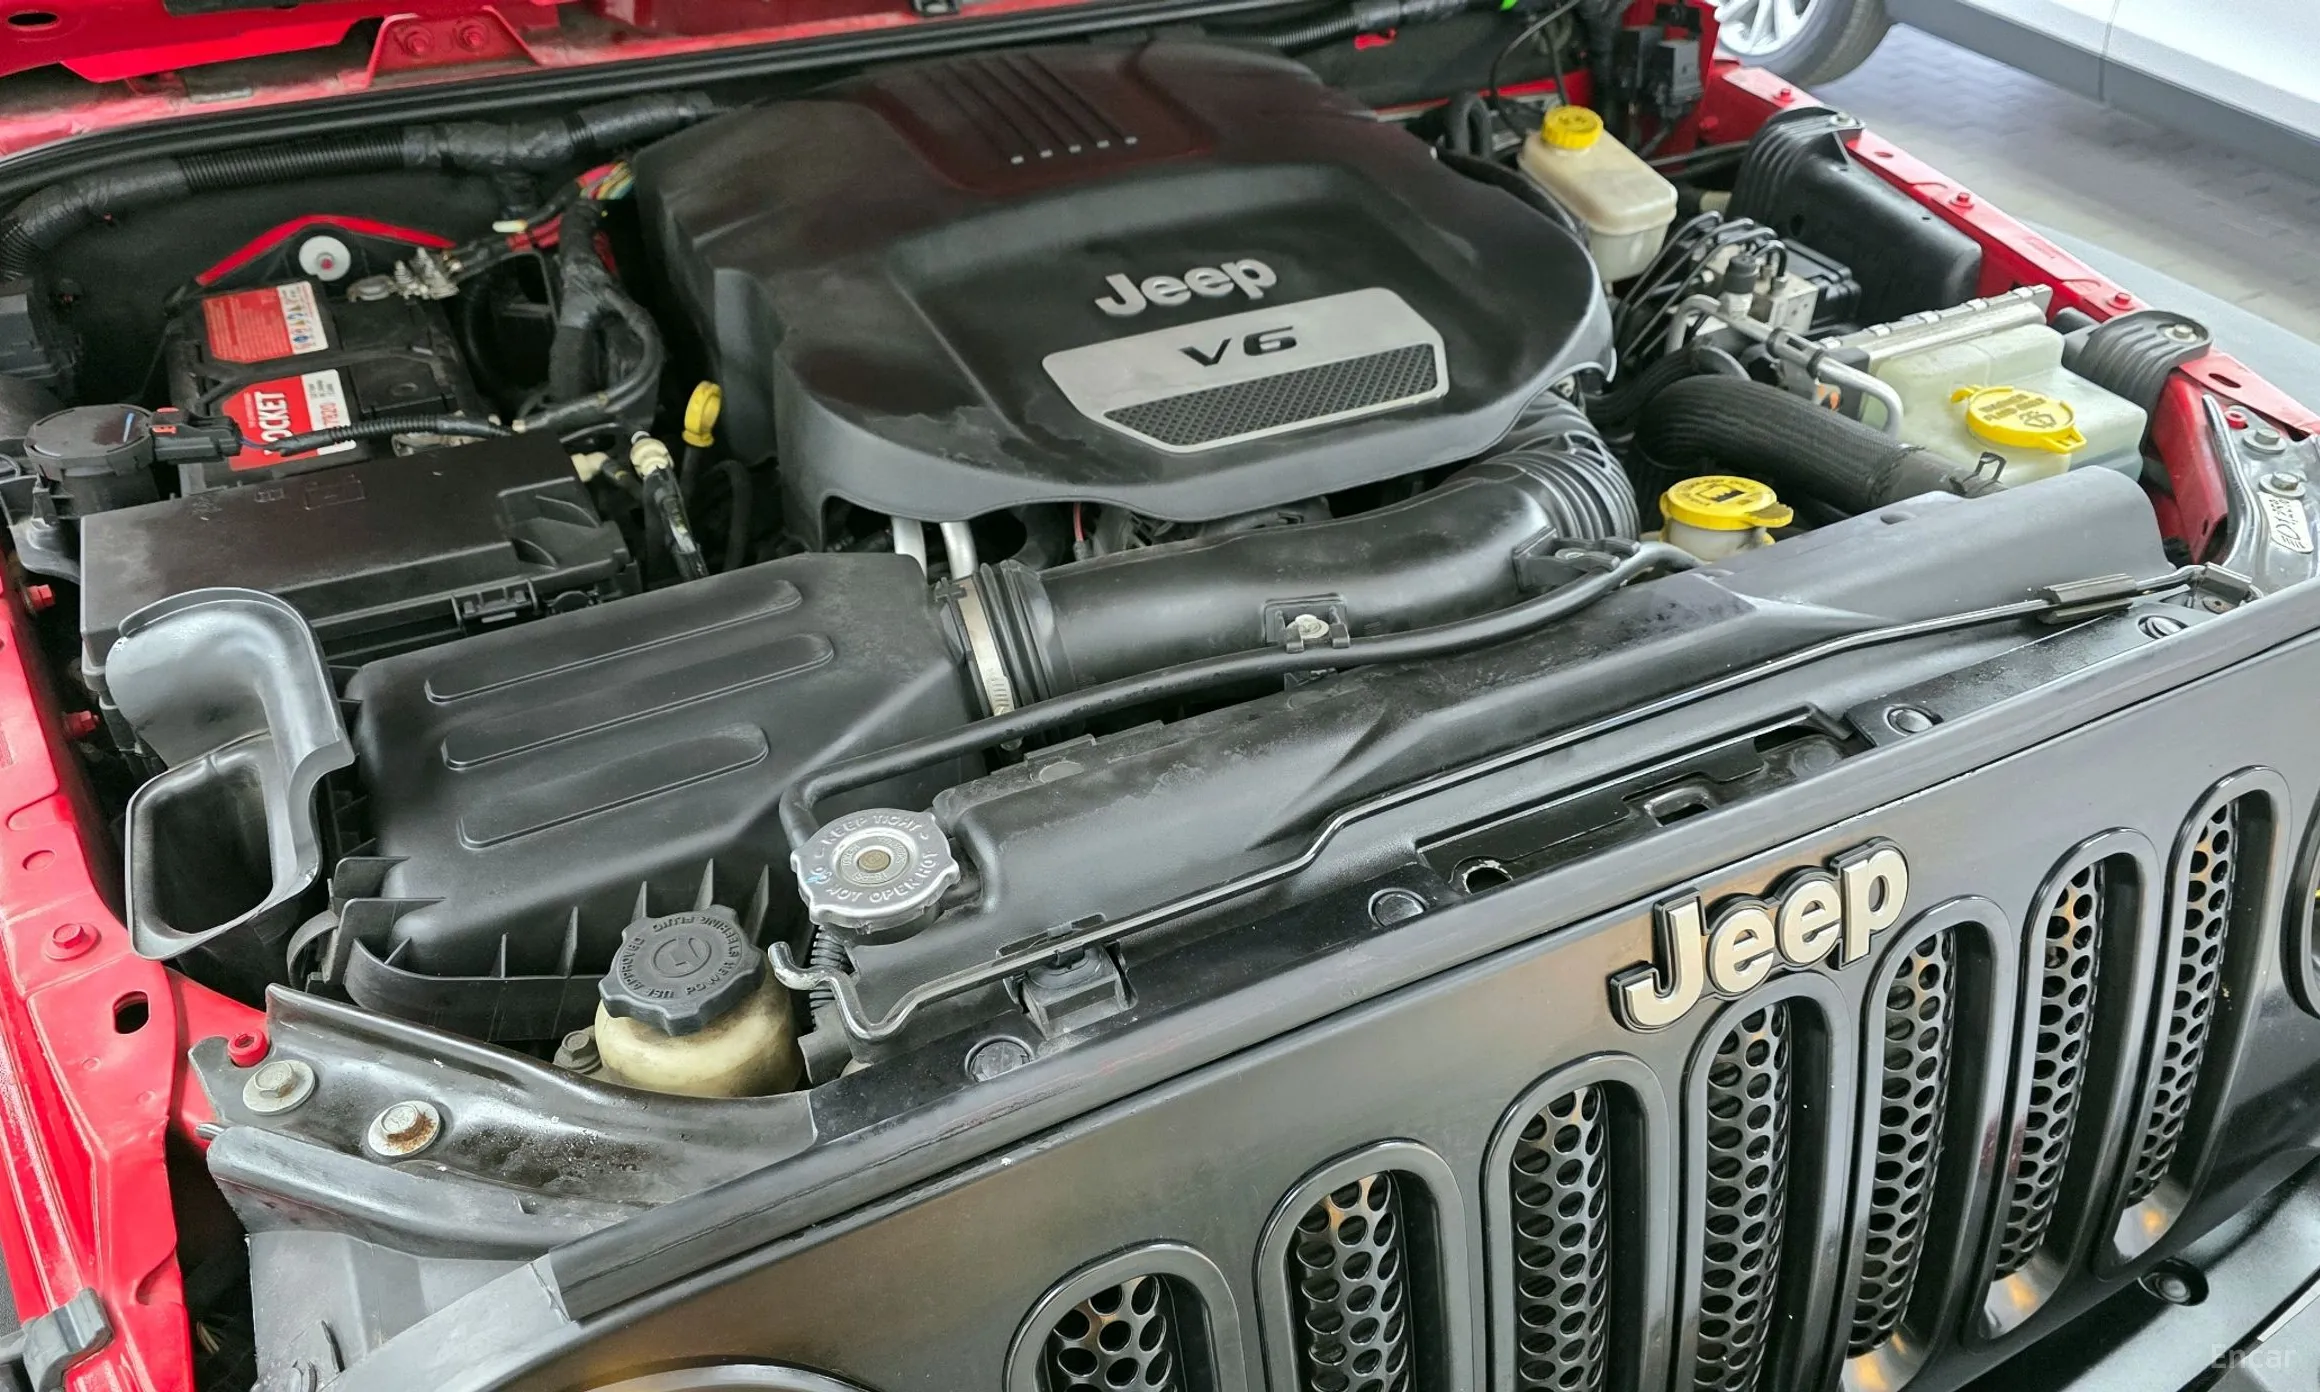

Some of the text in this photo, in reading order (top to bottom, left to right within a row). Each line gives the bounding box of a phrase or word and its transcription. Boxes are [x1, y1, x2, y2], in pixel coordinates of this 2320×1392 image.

[1094, 258, 1278, 318] Jeep
[1178, 325, 1298, 367] V6
[254, 391, 296, 455] OCKET
[820, 816, 867, 845] KEEP
[826, 887, 863, 903] NOT
[869, 878, 921, 903] OPEN
[915, 850, 940, 879] HOT
[700, 916, 741, 958] STEERING
[1613, 840, 1909, 1029] Jeep
[620, 937, 647, 990] APPROVED
[685, 961, 735, 995] POWER
